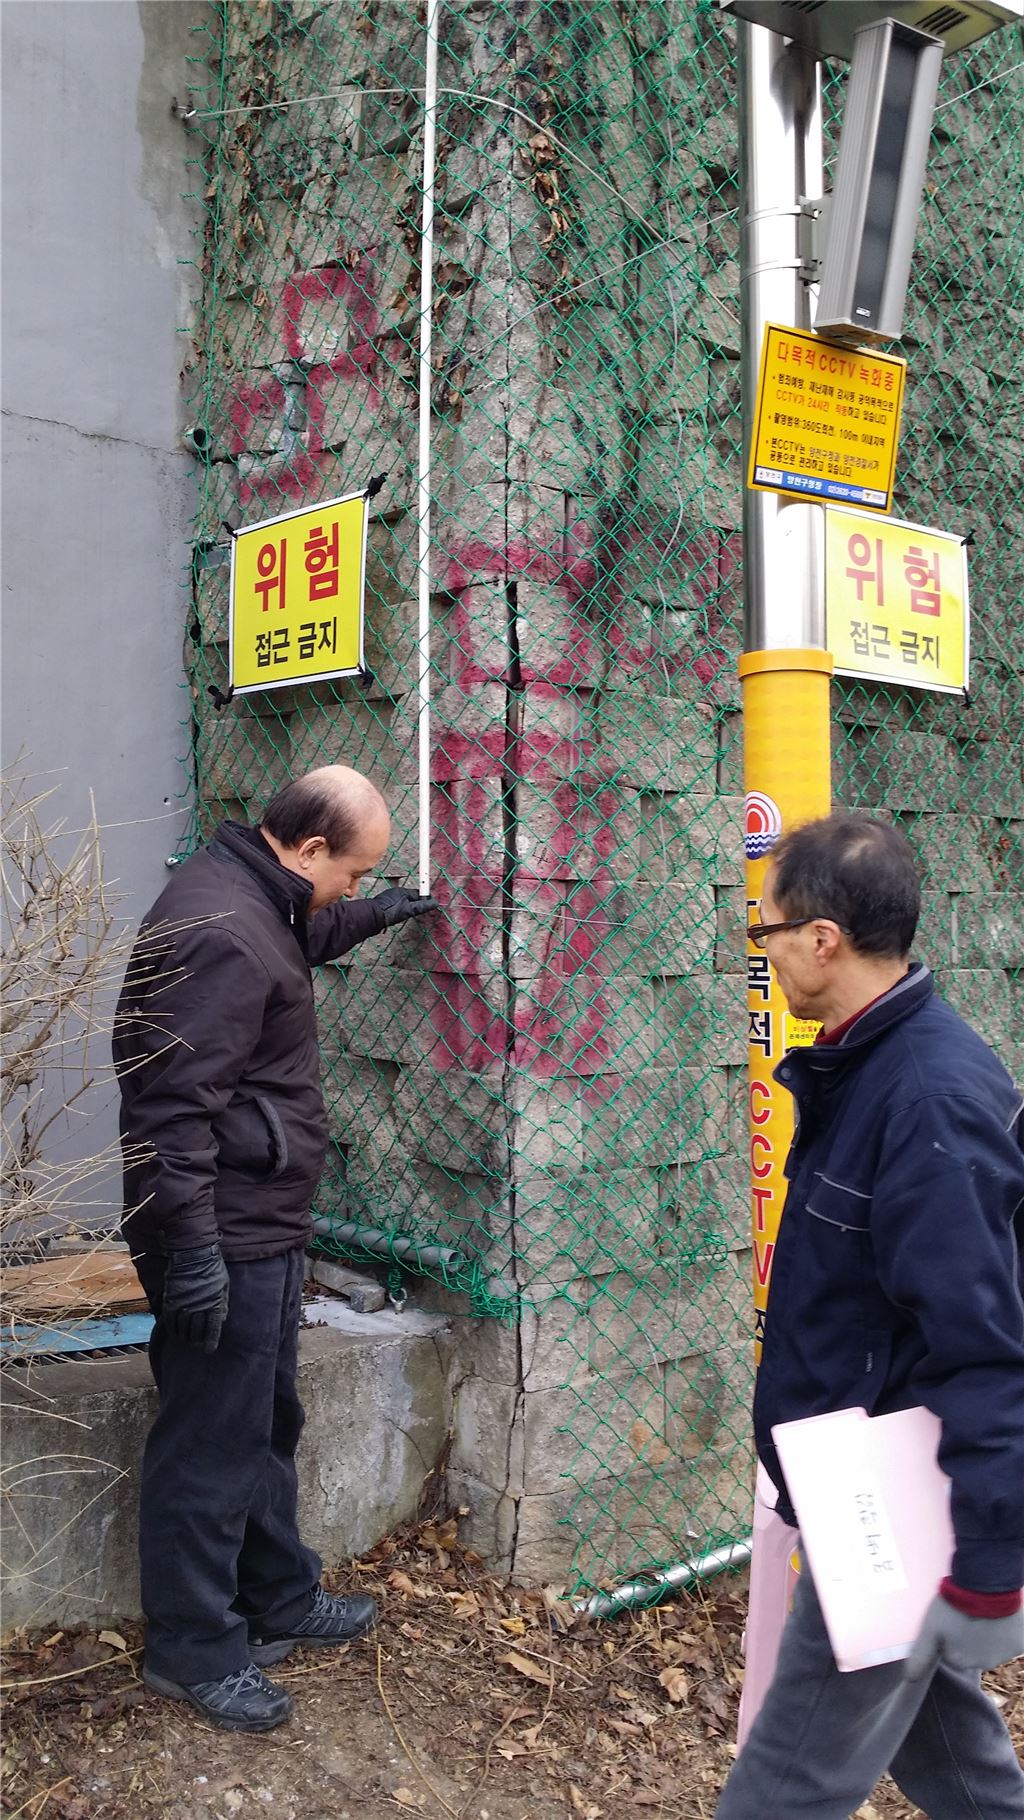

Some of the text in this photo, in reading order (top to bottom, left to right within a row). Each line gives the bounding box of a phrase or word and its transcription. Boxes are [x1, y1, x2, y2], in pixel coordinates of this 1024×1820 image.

[807, 397, 829, 411] 24시간
[839, 428, 858, 441] 100m
[255, 616, 337, 668] 접근 금지
[850, 621, 940, 669] 접근 금지
